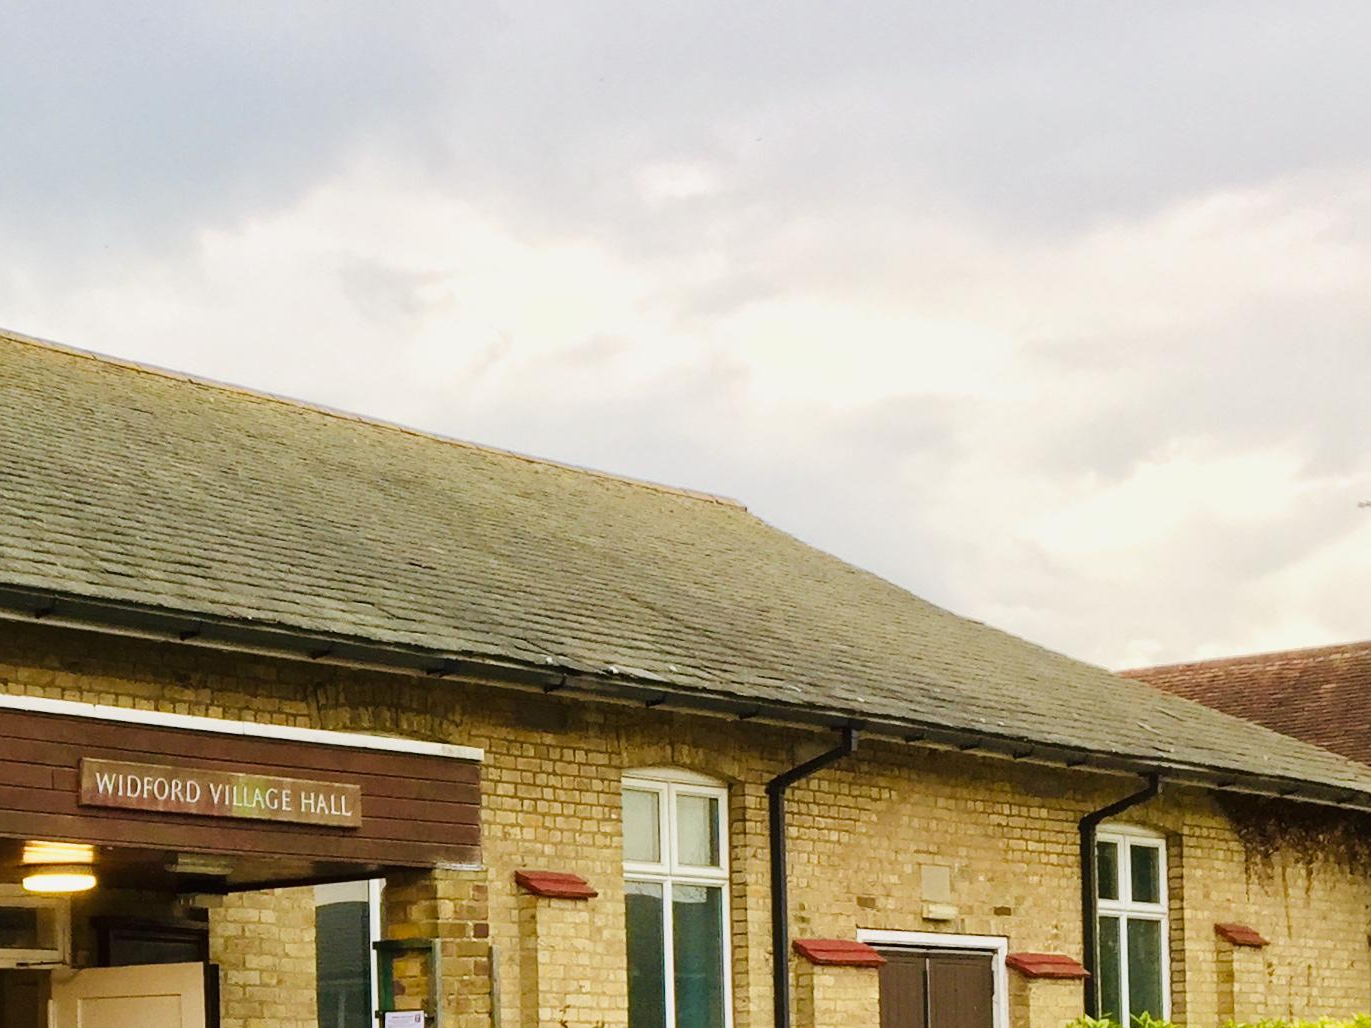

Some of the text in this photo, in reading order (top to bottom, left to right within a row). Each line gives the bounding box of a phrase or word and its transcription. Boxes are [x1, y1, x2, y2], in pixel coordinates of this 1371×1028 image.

[95, 772, 352, 817] WIDFORD VILLAGE HALL
